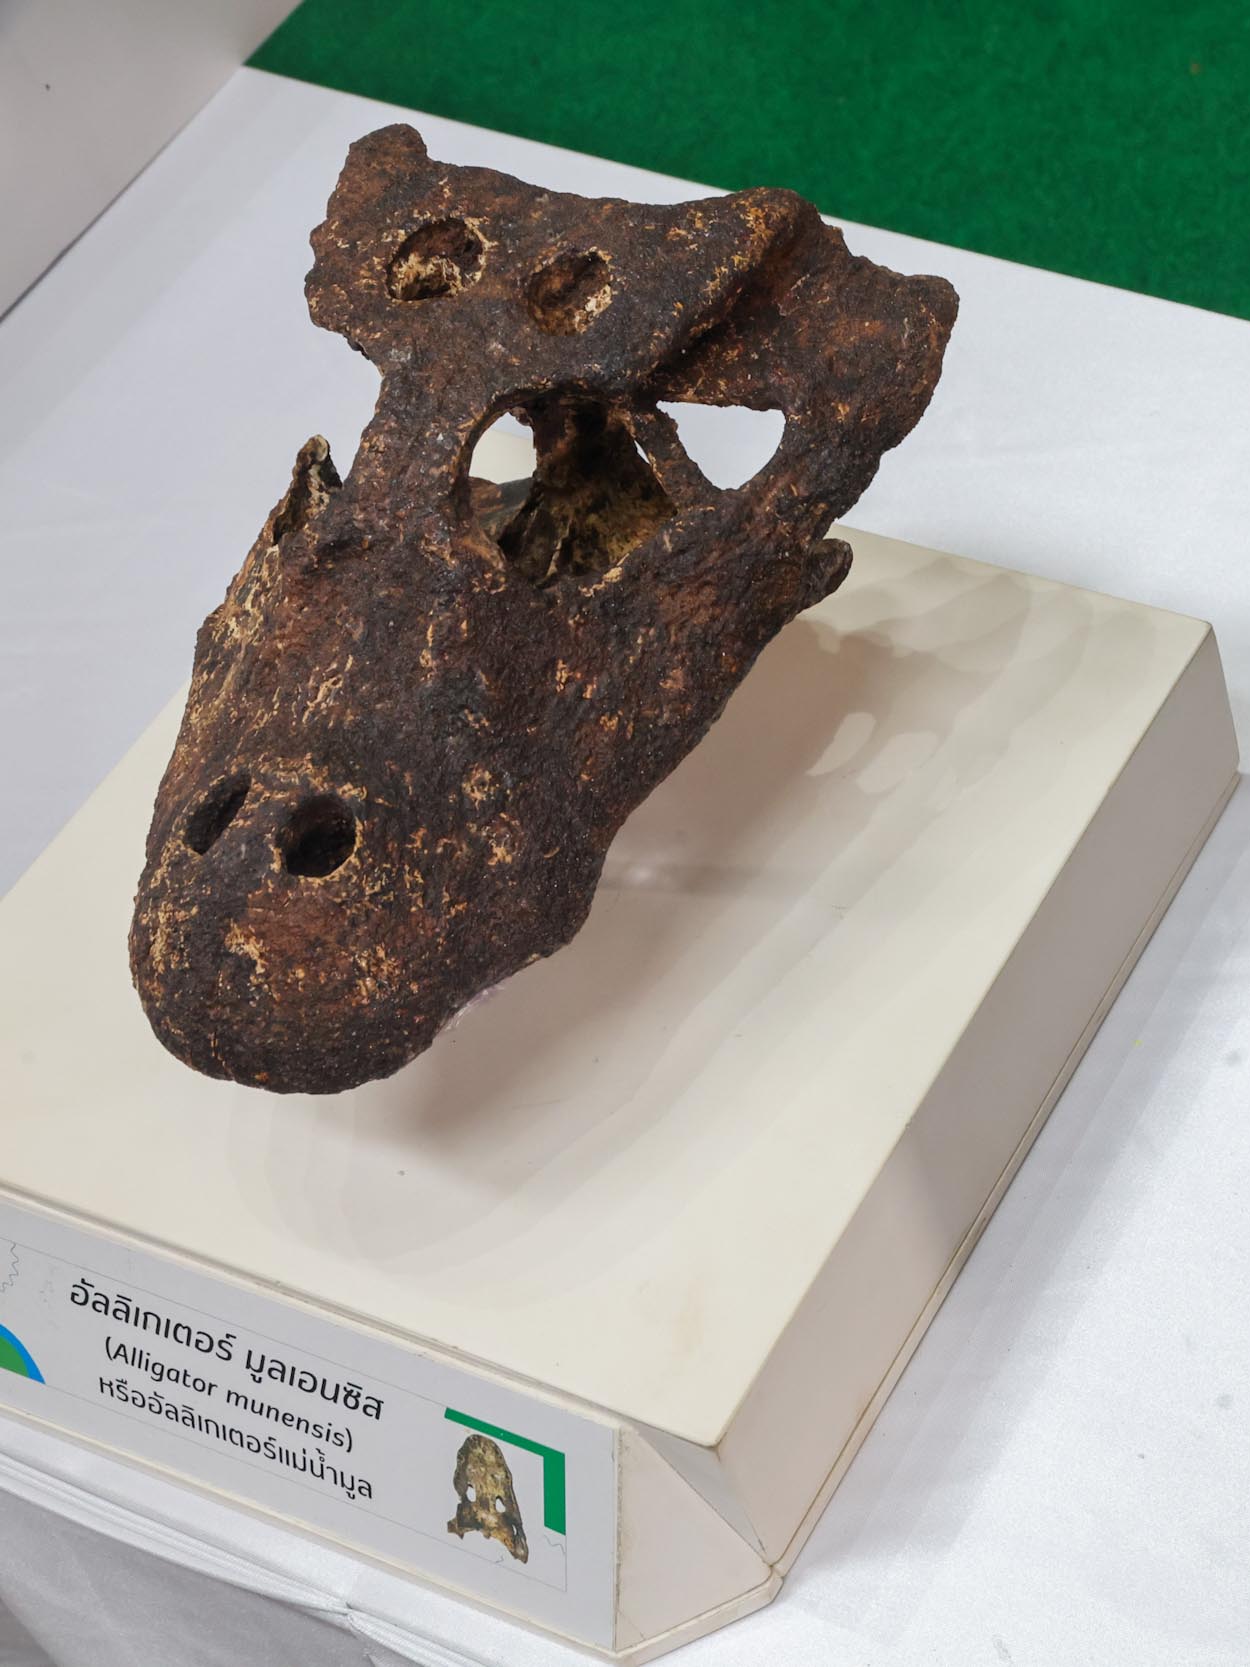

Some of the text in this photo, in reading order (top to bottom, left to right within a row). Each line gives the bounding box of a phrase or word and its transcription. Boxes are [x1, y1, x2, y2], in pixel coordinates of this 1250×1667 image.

[70, 1277, 385, 1421] อัลลิเกเตอร์ มูลเอนซิส
[105, 1336, 353, 1453] (Alligator munensis)
[99, 1376, 373, 1500] หรืออัลลิเกเตอร์แม่น้ำมูล
